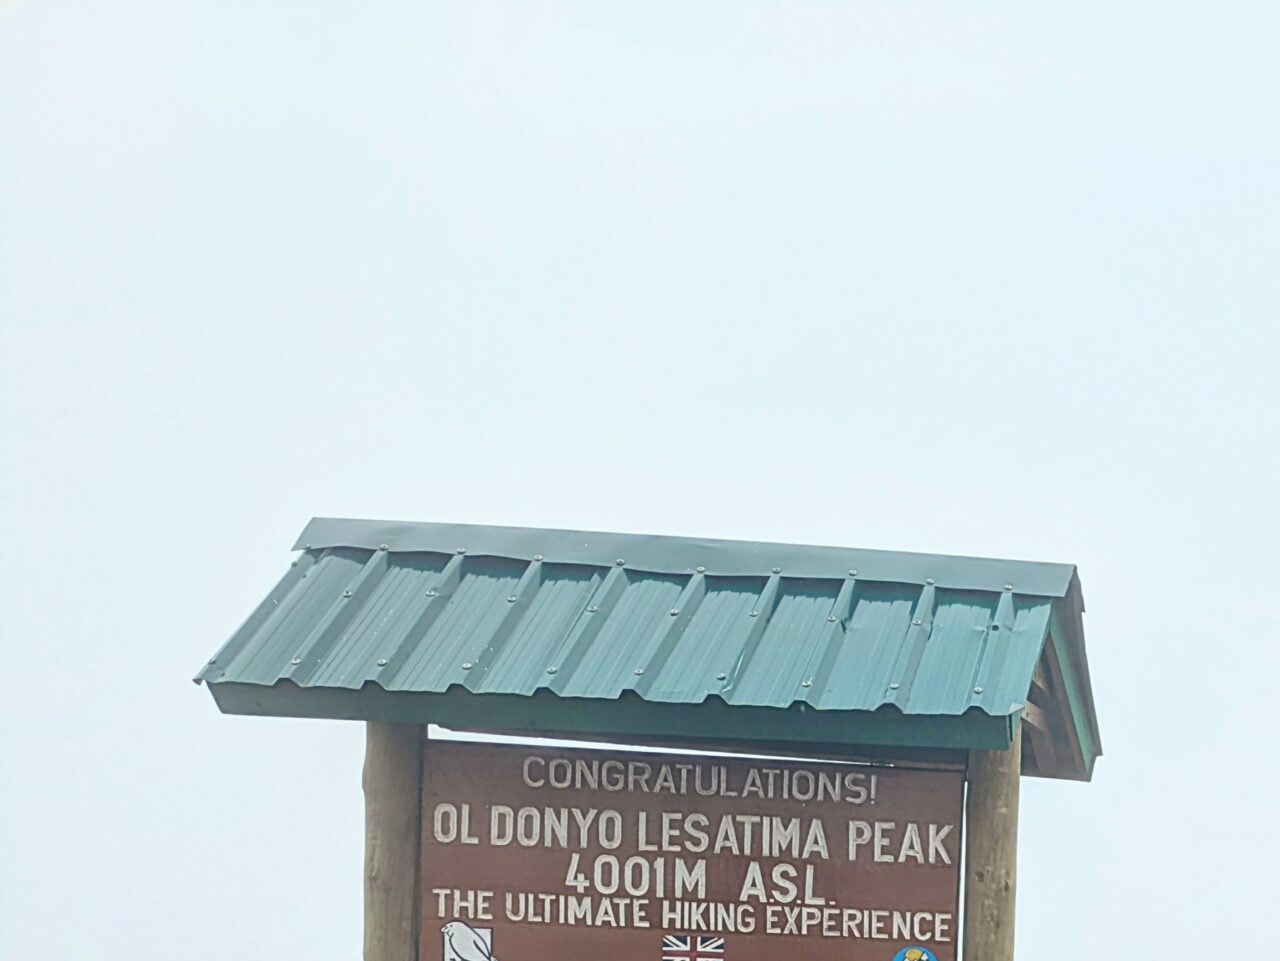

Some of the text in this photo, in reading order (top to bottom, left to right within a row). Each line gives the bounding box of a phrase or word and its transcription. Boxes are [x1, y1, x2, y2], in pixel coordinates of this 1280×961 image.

[523, 756, 877, 804] CONGRATULATIONS!
[434, 803, 954, 864] OL DONYO LESATIMA PEAK
[432, 889, 952, 942] THE ULTIMATE HIKING EXPERIENCE
